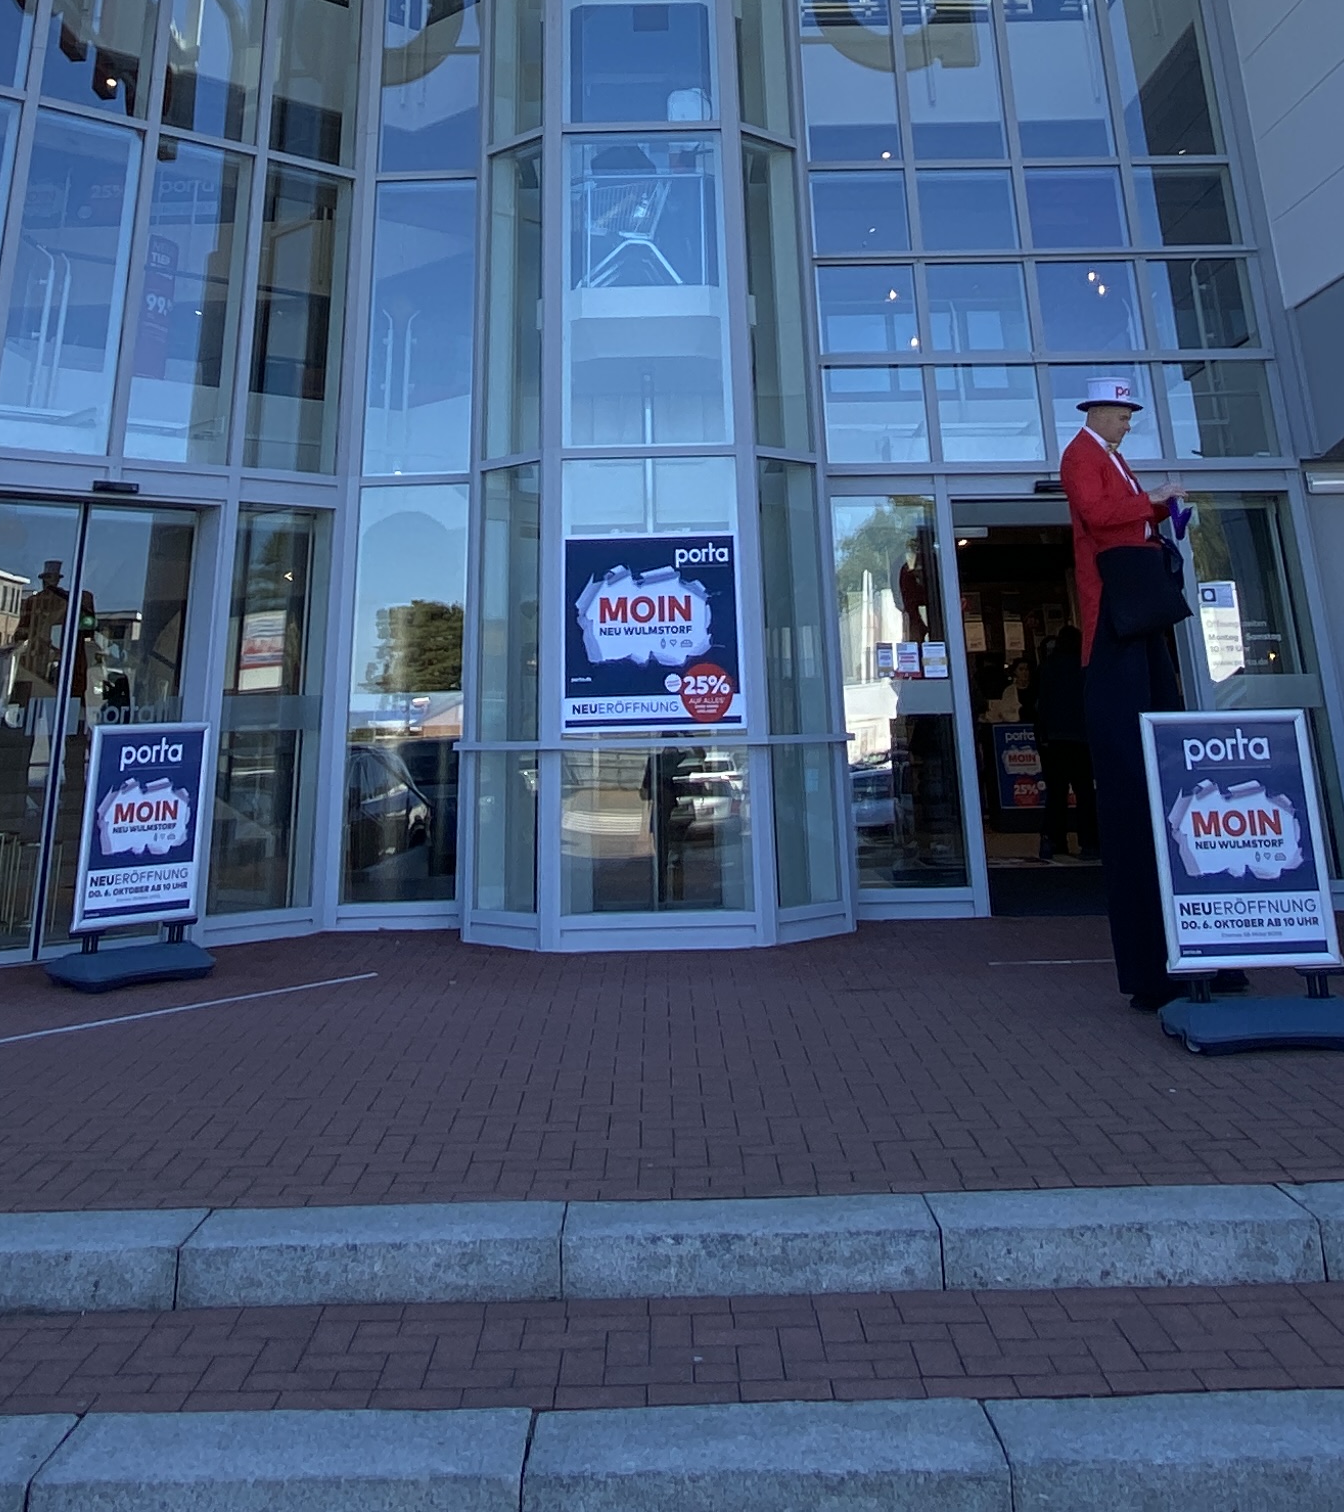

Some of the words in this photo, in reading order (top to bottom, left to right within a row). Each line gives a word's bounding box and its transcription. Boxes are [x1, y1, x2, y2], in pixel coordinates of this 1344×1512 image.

[675, 542, 729, 567] porta
[599, 595, 692, 624] MOIN
[599, 627, 622, 637] NEU
[623, 625, 692, 636] WULMSTORF
[683, 675, 730, 695] 25%
[572, 700, 679, 715] NEUERÖFFNUNG
[119, 737, 183, 772] porta
[1183, 728, 1270, 770] porta
[114, 800, 178, 824] MOIN
[112, 826, 128, 834] NEU
[129, 823, 177, 832] WULMSTORF
[1191, 809, 1282, 837] MOIN
[1195, 841, 1216, 849] NEU
[1217, 839, 1284, 849] WULMSTORF
[90, 868, 188, 887] NEUERÖFFNUNG
[88, 890, 102, 898] DO.
[112, 886, 149, 896] OKTOBER
[150, 884, 161, 892] AB
[163, 883, 171, 891] 10
[172, 881, 188, 890] UHR
[1179, 898, 1316, 916] NEUERÖFFNUNG
[1181, 920, 1201, 930] DO.
[1203, 919, 1212, 929] 6.
[1214, 919, 1264, 929] OKTOBER
[1266, 918, 1281, 928] AB
[1284, 917, 1295, 927] 10
[1296, 916, 1319, 926] UHR
